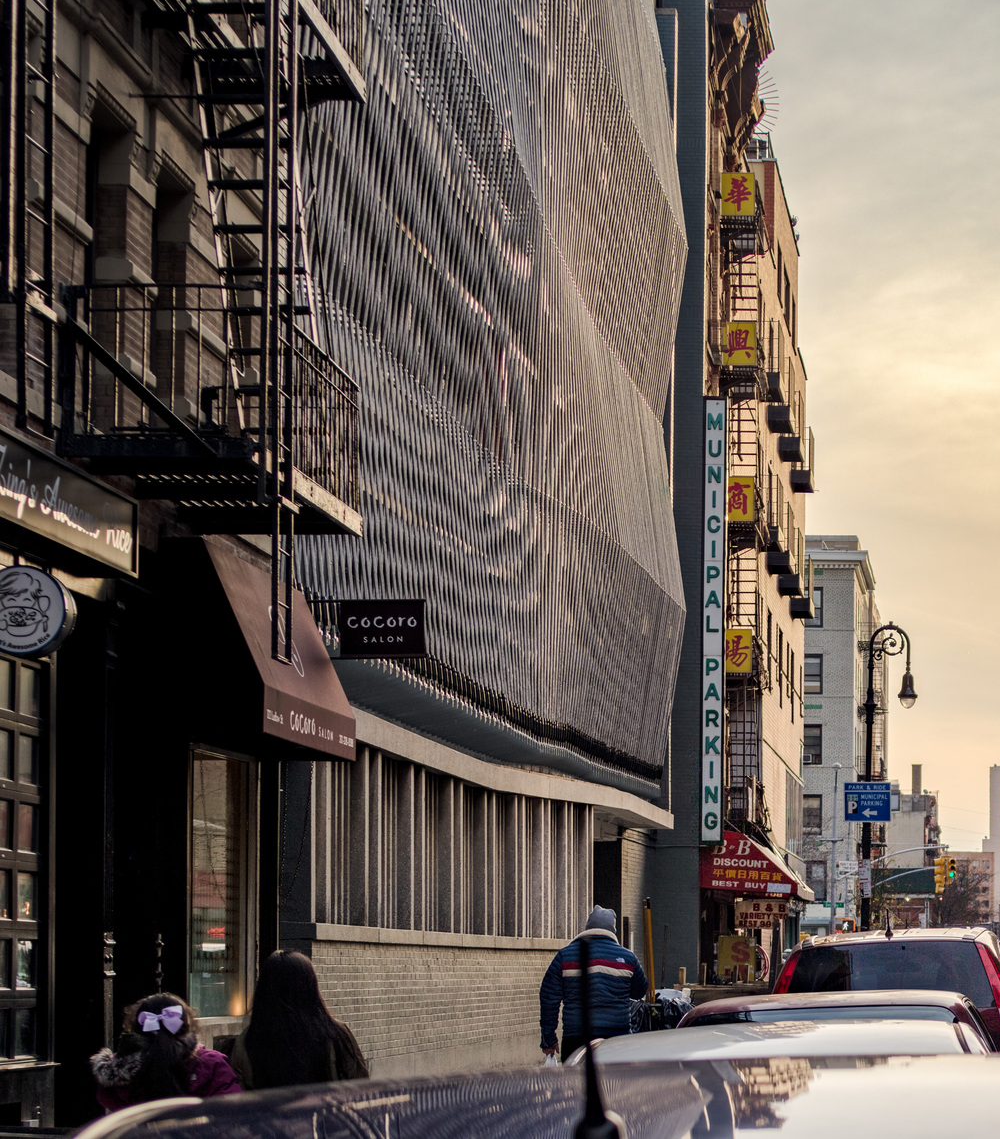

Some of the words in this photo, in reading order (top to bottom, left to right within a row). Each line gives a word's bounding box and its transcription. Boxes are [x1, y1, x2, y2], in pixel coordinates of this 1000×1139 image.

[724, 176, 752, 212] 華
[705, 413, 723, 633] MUNICIPAL
[37, 633, 51, 645] Rice
[363, 636, 404, 644] SALON
[318, 726, 334, 741] SALON
[704, 658, 721, 831] PARKING
[848, 802, 858, 814] P
[736, 840, 751, 856] B
[713, 858, 769, 869] DISCOUNT
[712, 880, 740, 888] BEST
[744, 882, 766, 890] BUY
[752, 903, 760, 912] B
[765, 903, 773, 912] &
[778, 904, 786, 912] B
